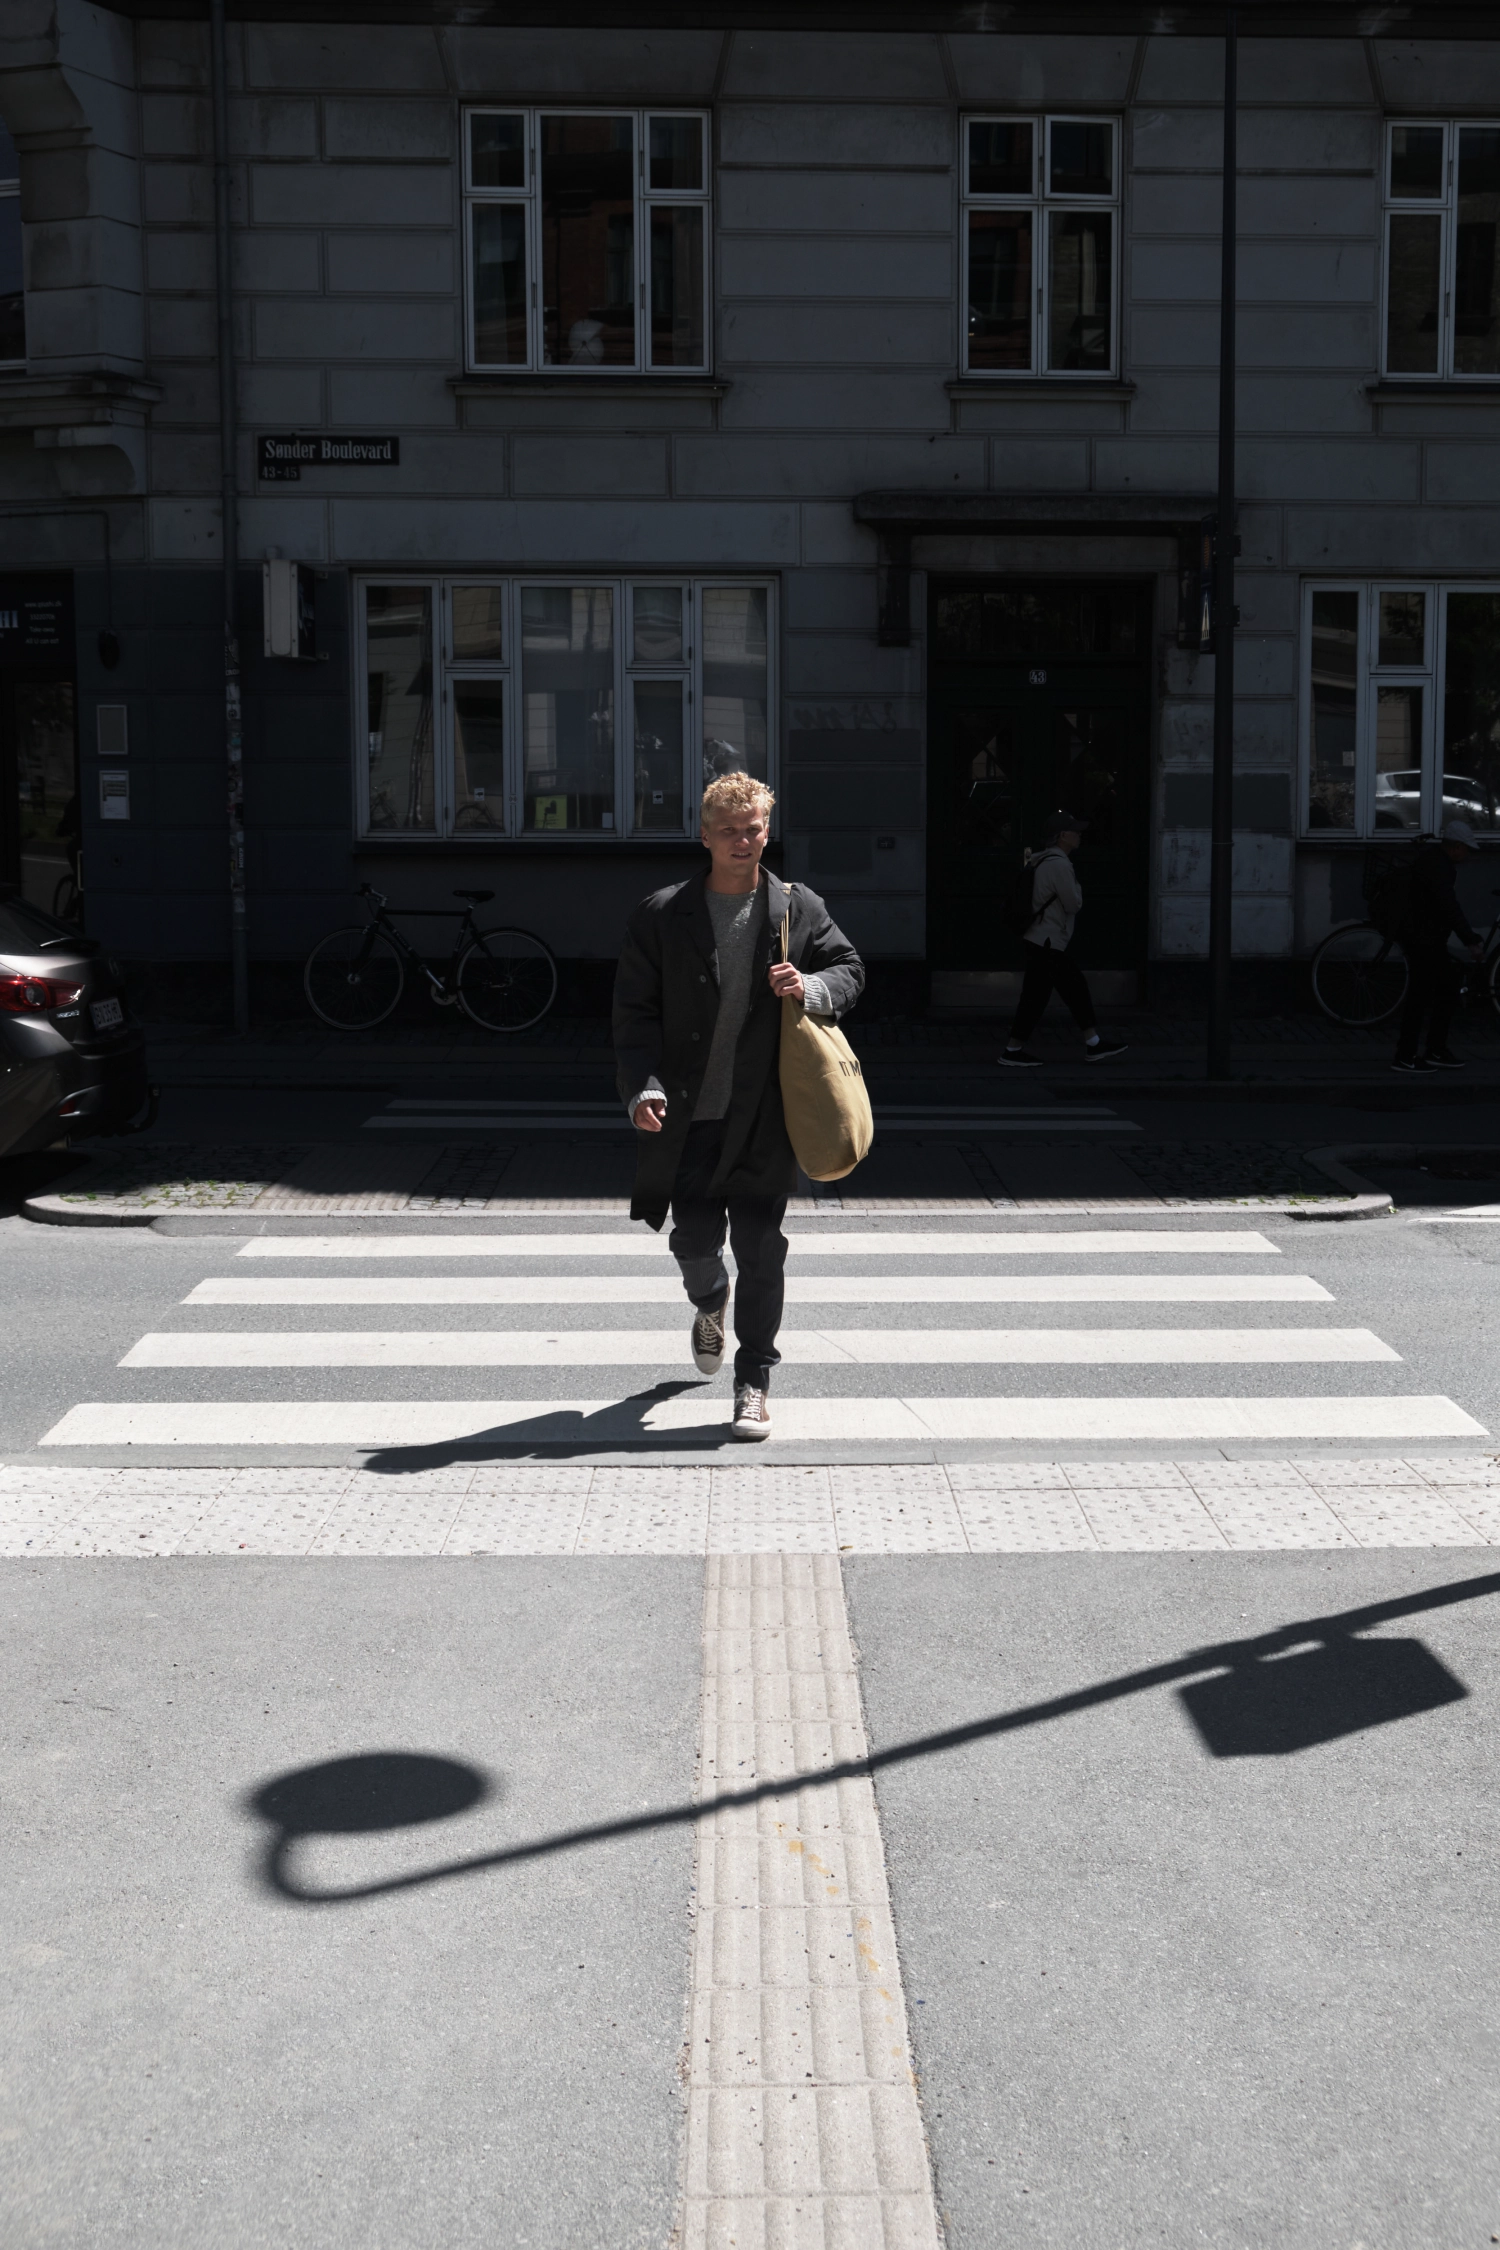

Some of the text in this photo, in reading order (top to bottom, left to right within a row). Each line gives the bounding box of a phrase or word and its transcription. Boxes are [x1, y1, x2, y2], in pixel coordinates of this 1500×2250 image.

[265, 440, 392, 459] Sønder Boulevard
[262, 466, 298, 479] 43-45
[1030, 671, 1045, 683] 43
